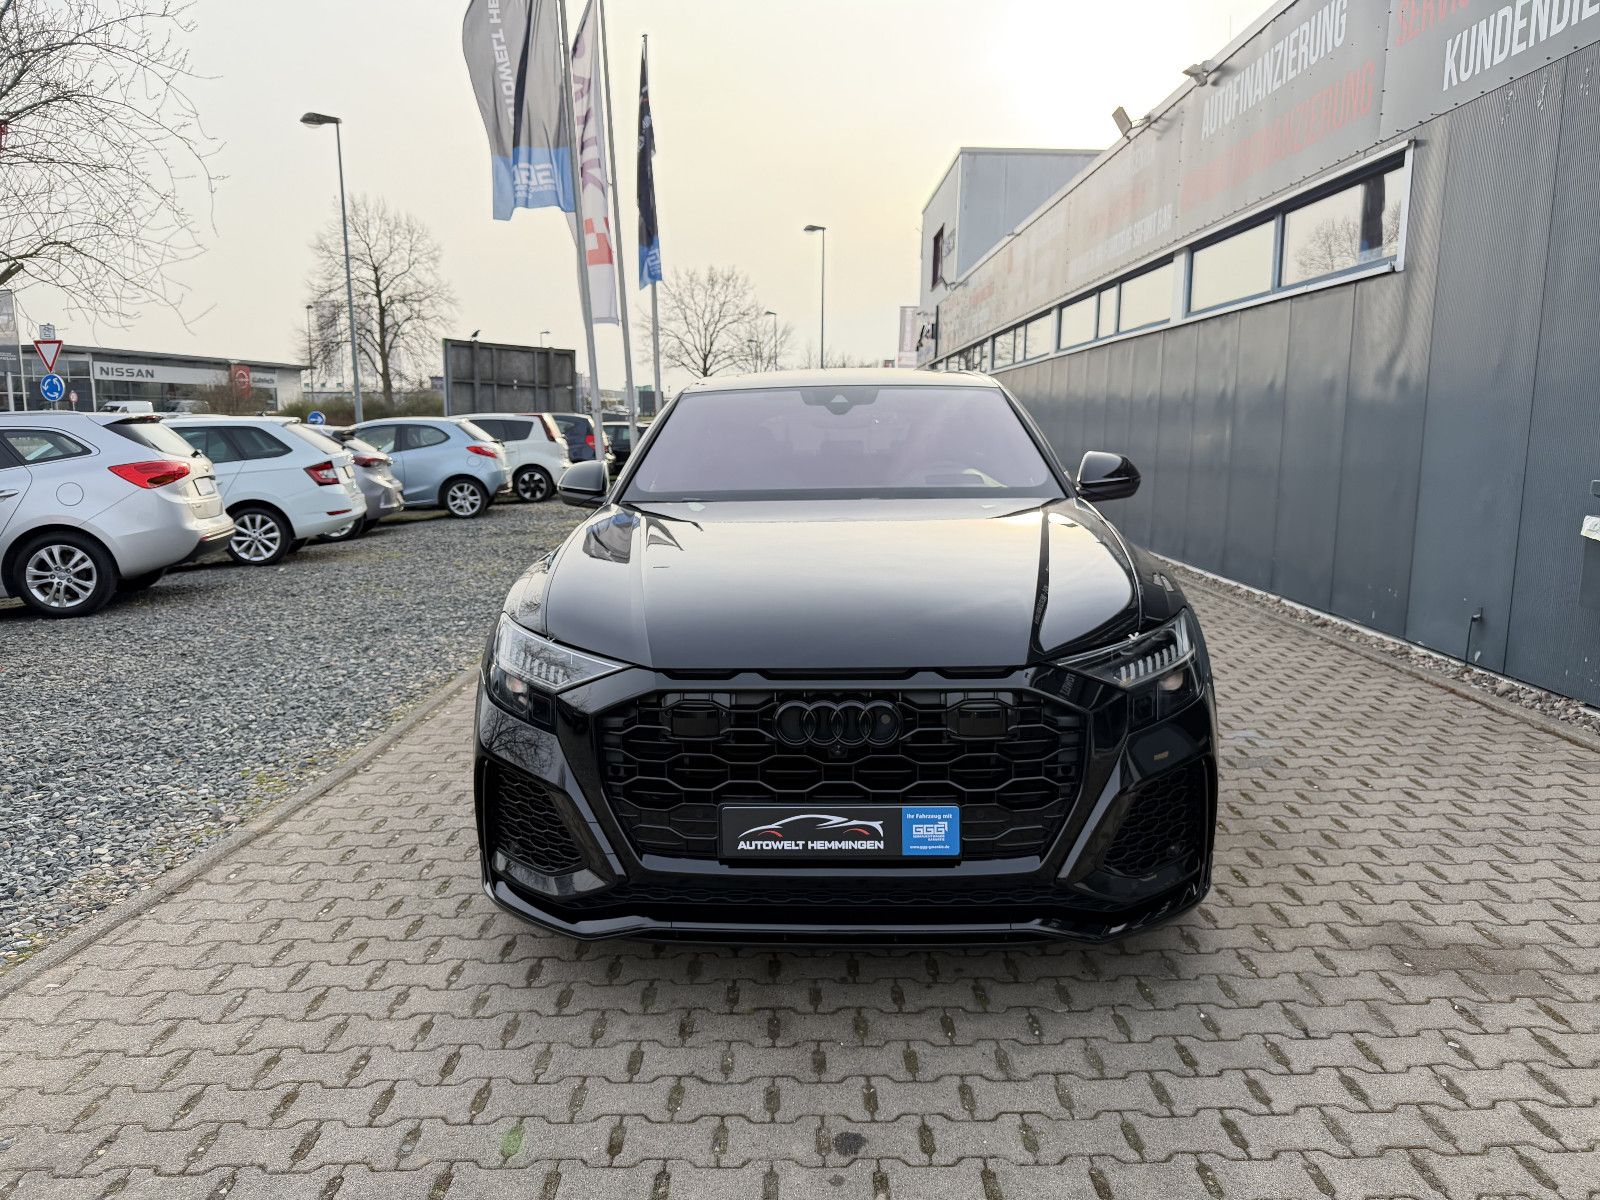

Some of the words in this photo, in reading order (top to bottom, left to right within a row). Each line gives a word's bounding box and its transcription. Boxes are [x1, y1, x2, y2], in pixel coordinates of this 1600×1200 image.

[1201, 0, 1348, 141] AUTOFINANZIERUNG
[99, 366, 155, 378] NISSAN
[912, 824, 946, 835] GGG
[737, 840, 805, 850] AUTOWELT
[807, 840, 884, 850] HEMMINGEN
